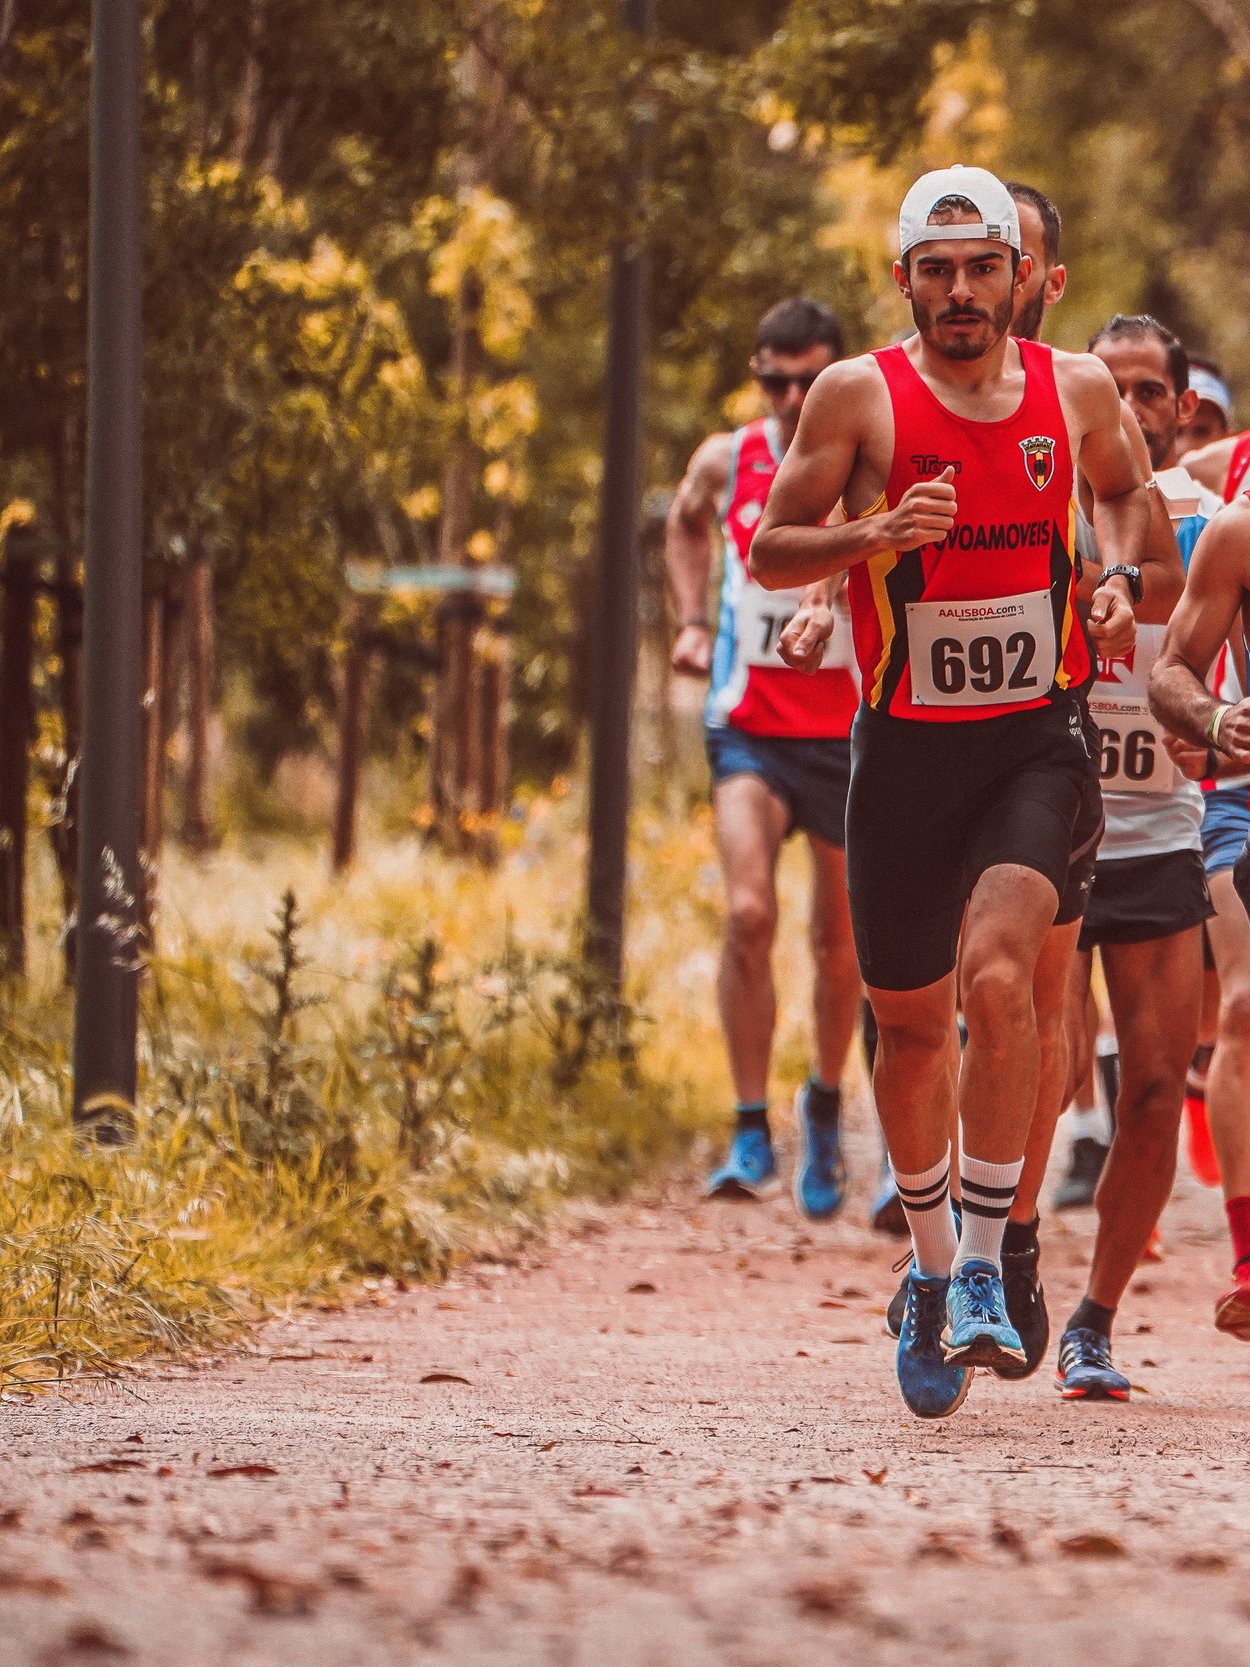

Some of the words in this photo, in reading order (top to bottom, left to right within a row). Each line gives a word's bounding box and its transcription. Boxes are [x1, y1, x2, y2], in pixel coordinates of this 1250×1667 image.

[920, 520, 1050, 552] VOAMOVEIS
[939, 605, 1017, 618] AALISBOA.com
[931, 631, 1038, 694] 692
[1099, 728, 1156, 781] 66
